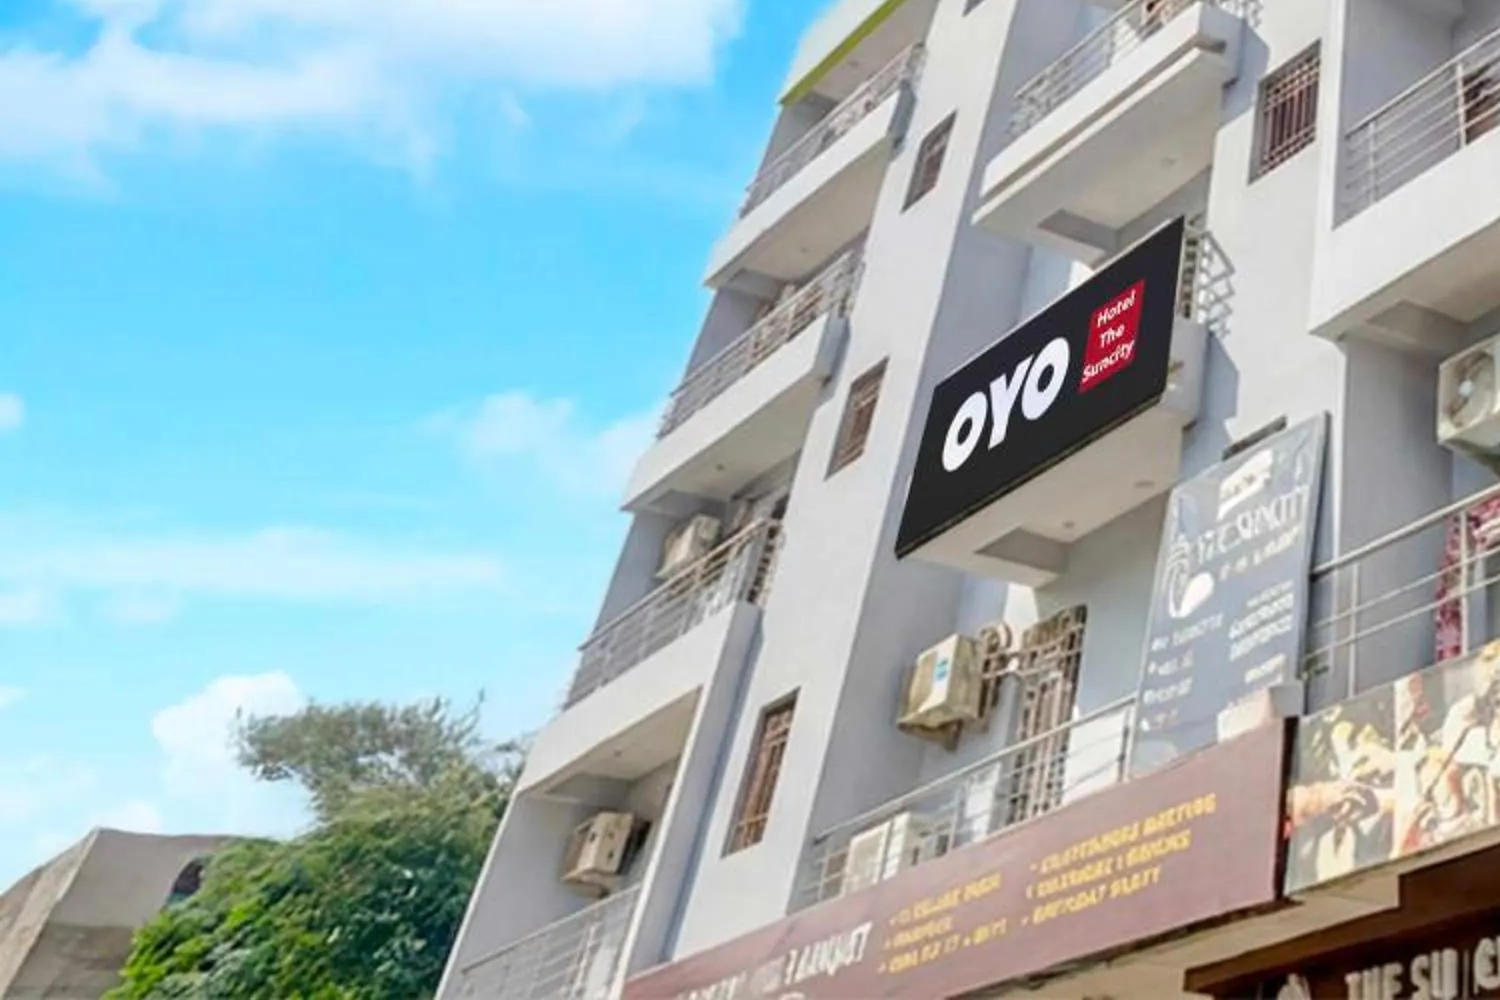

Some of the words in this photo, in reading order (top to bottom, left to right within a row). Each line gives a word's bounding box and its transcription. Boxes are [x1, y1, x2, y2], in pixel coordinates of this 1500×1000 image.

[1097, 288, 1136, 328] Hotel
[1100, 324, 1125, 348] The
[1081, 340, 1135, 384] Suncity
[942, 337, 1070, 472] OYO
[1344, 962, 1403, 1000] THE
